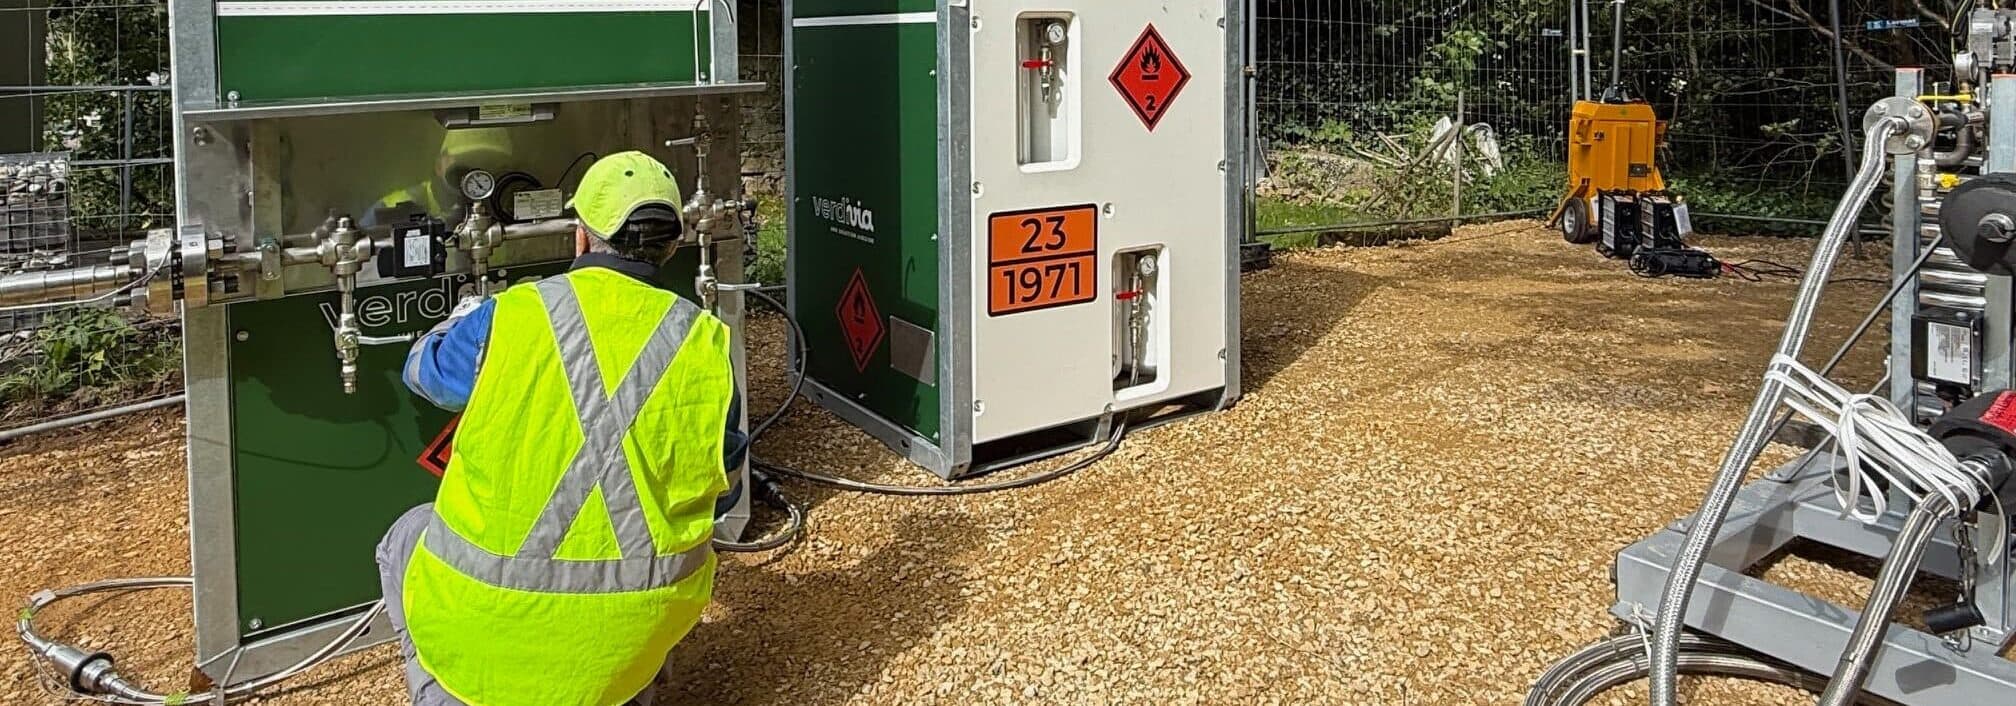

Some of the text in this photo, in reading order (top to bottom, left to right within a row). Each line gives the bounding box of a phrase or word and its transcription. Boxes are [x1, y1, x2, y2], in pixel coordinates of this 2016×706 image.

[1145, 95, 1156, 111] 2
[812, 196, 874, 232] verdivia
[1021, 215, 1066, 253] 23
[1003, 261, 1080, 305] 1971
